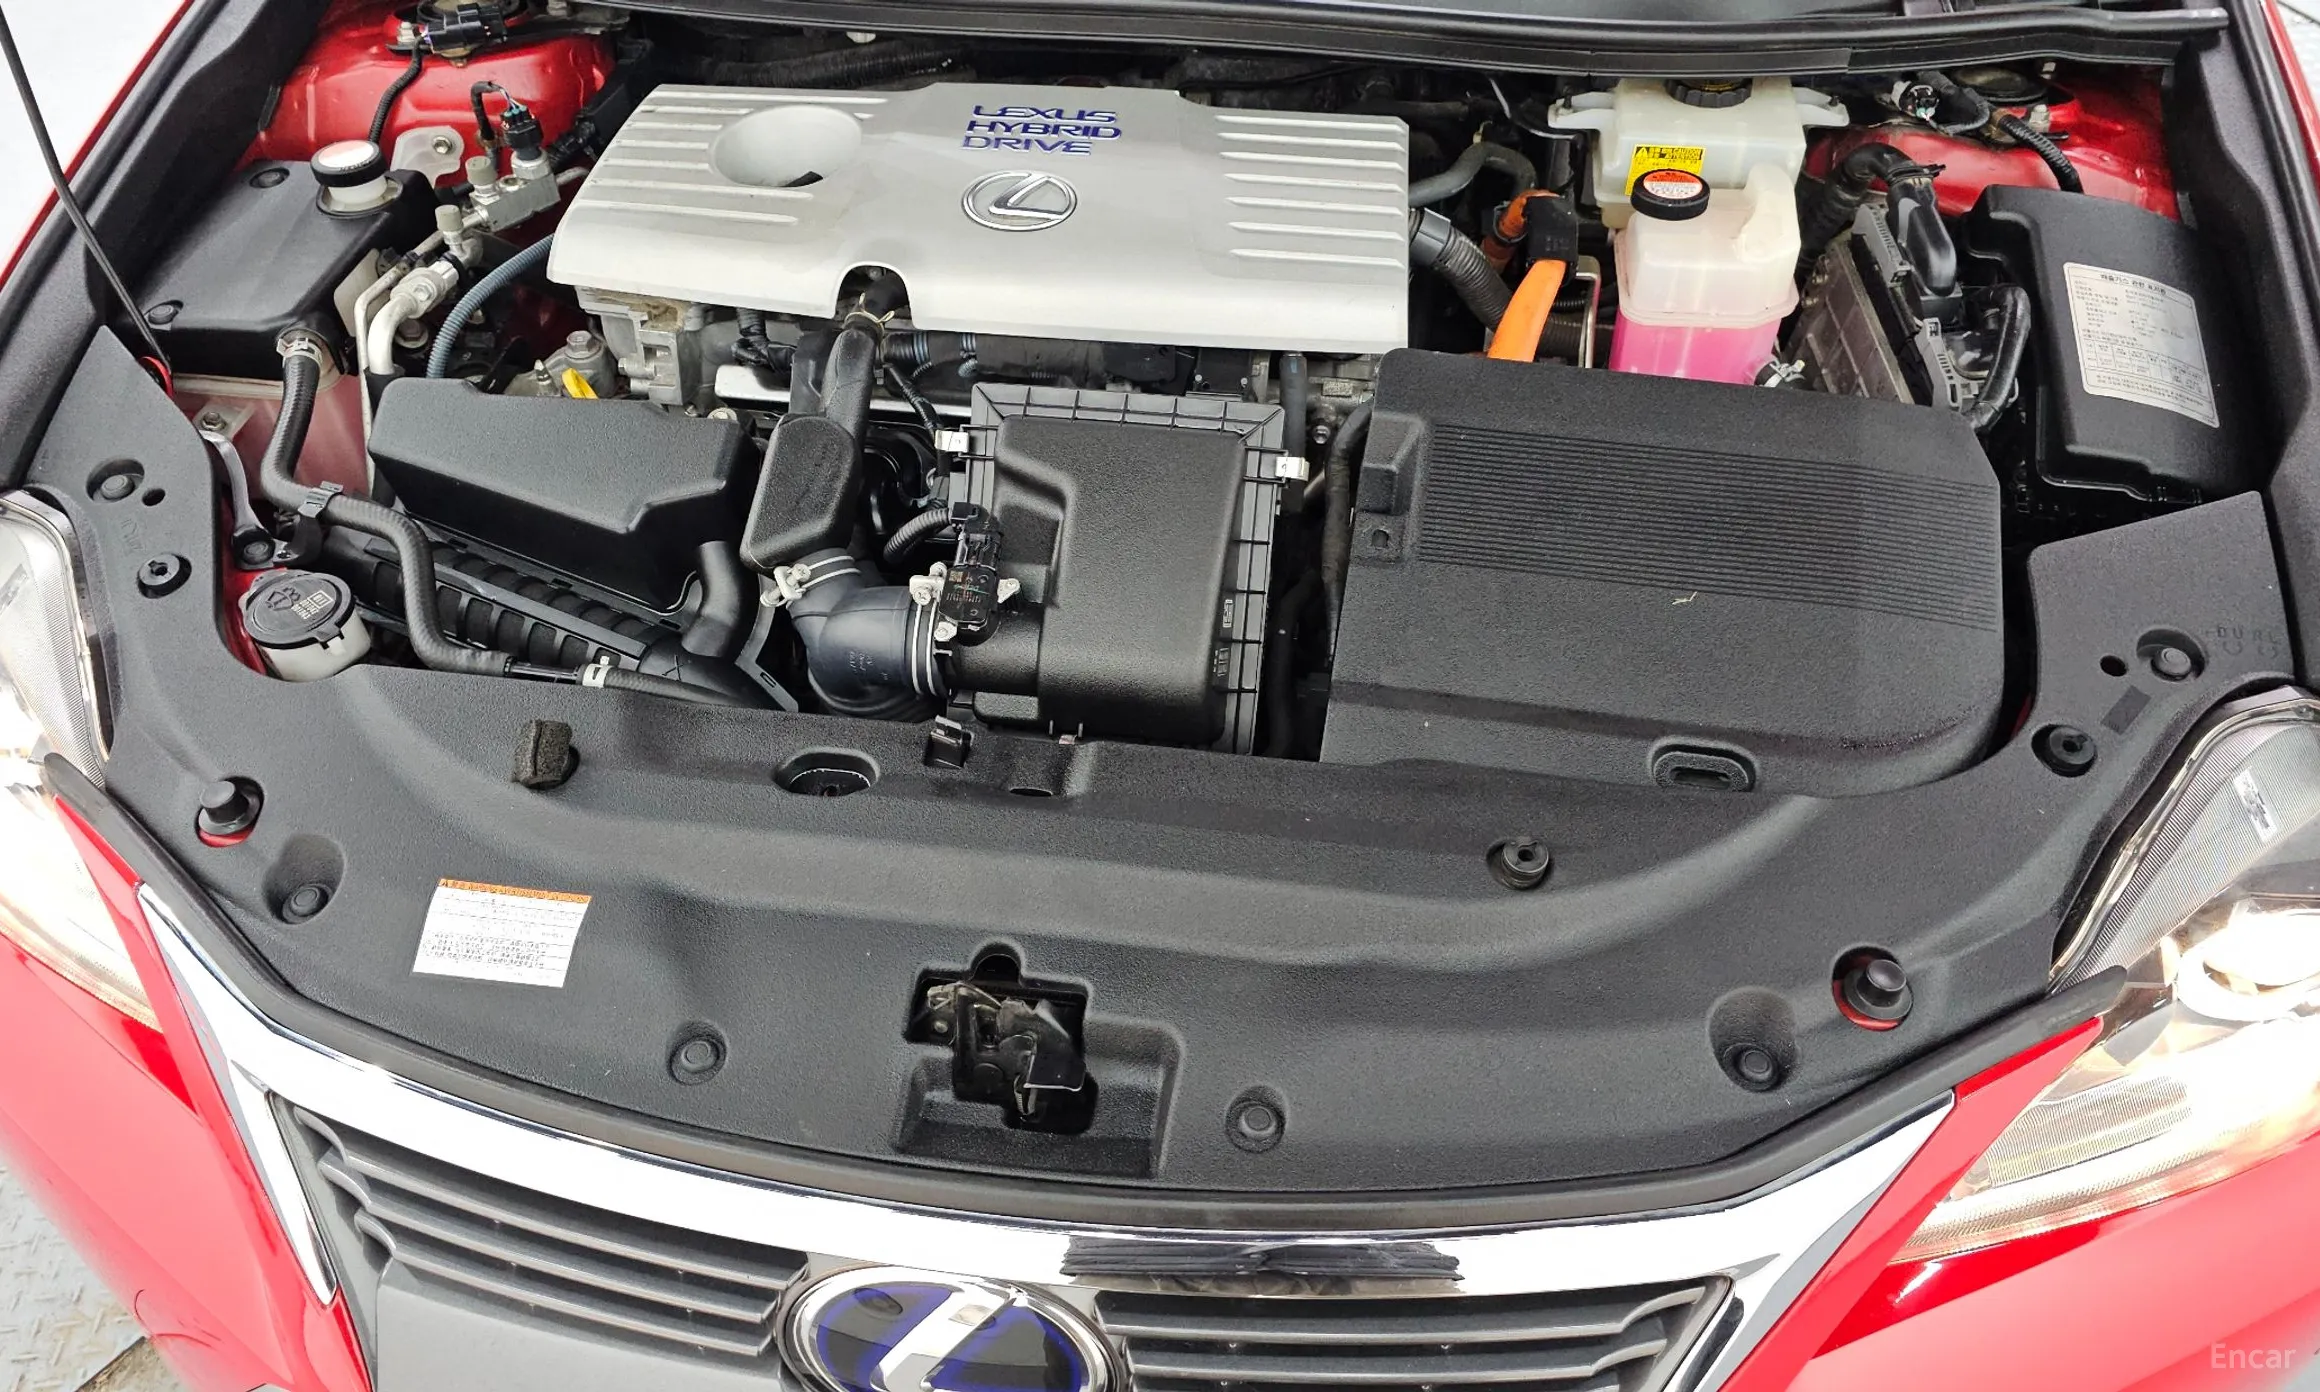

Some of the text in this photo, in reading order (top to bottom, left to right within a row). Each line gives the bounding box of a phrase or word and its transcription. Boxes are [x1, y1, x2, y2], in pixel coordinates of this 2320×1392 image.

[972, 105, 1117, 123] LEXUS
[966, 120, 1122, 139] HYBRID
[962, 135, 1093, 155] DRIVE
